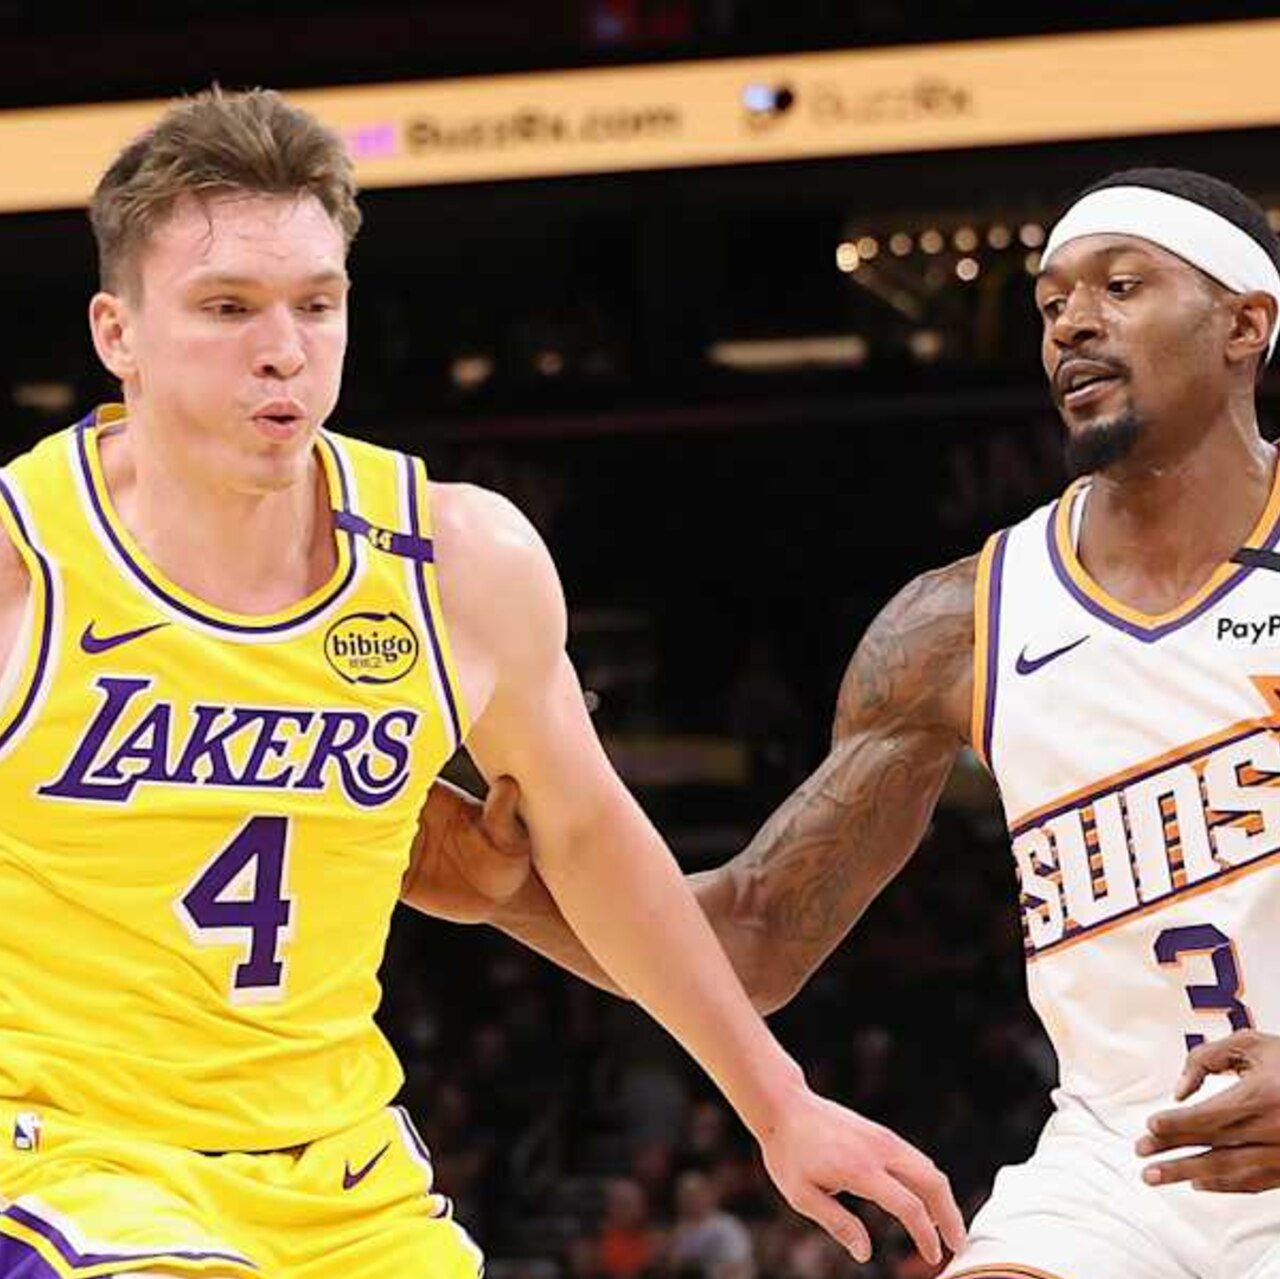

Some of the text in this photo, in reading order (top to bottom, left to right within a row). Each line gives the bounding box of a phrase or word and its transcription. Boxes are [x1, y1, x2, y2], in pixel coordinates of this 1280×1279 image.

[333, 632, 413, 663] bibigo
[37, 677, 418, 807] LAKERS
[180, 814, 293, 990] 4
[1152, 922, 1254, 1053] 3
